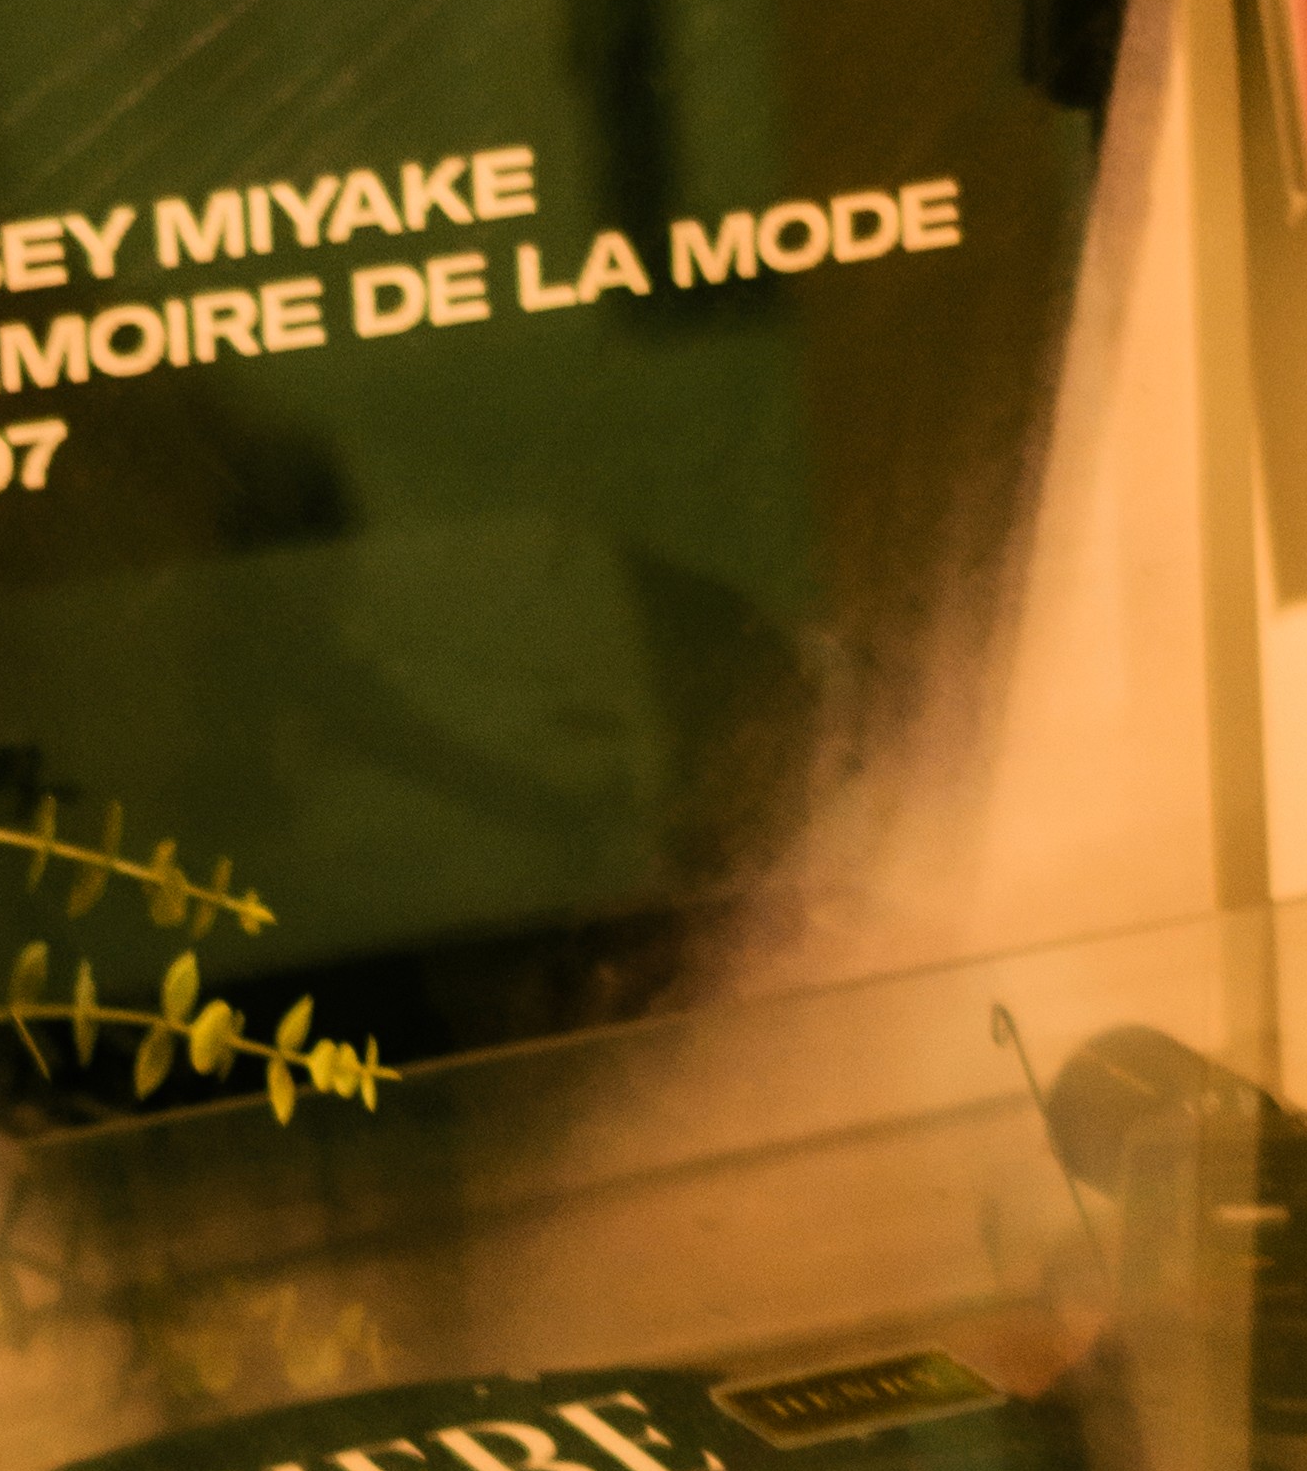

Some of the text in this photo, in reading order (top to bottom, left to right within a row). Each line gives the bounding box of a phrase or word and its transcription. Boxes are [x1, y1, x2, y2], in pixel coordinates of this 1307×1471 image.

[156, 145, 538, 267] MIYAKE
[352, 252, 490, 339] DE
[515, 230, 652, 313] LA
[668, 177, 963, 289] MODE
